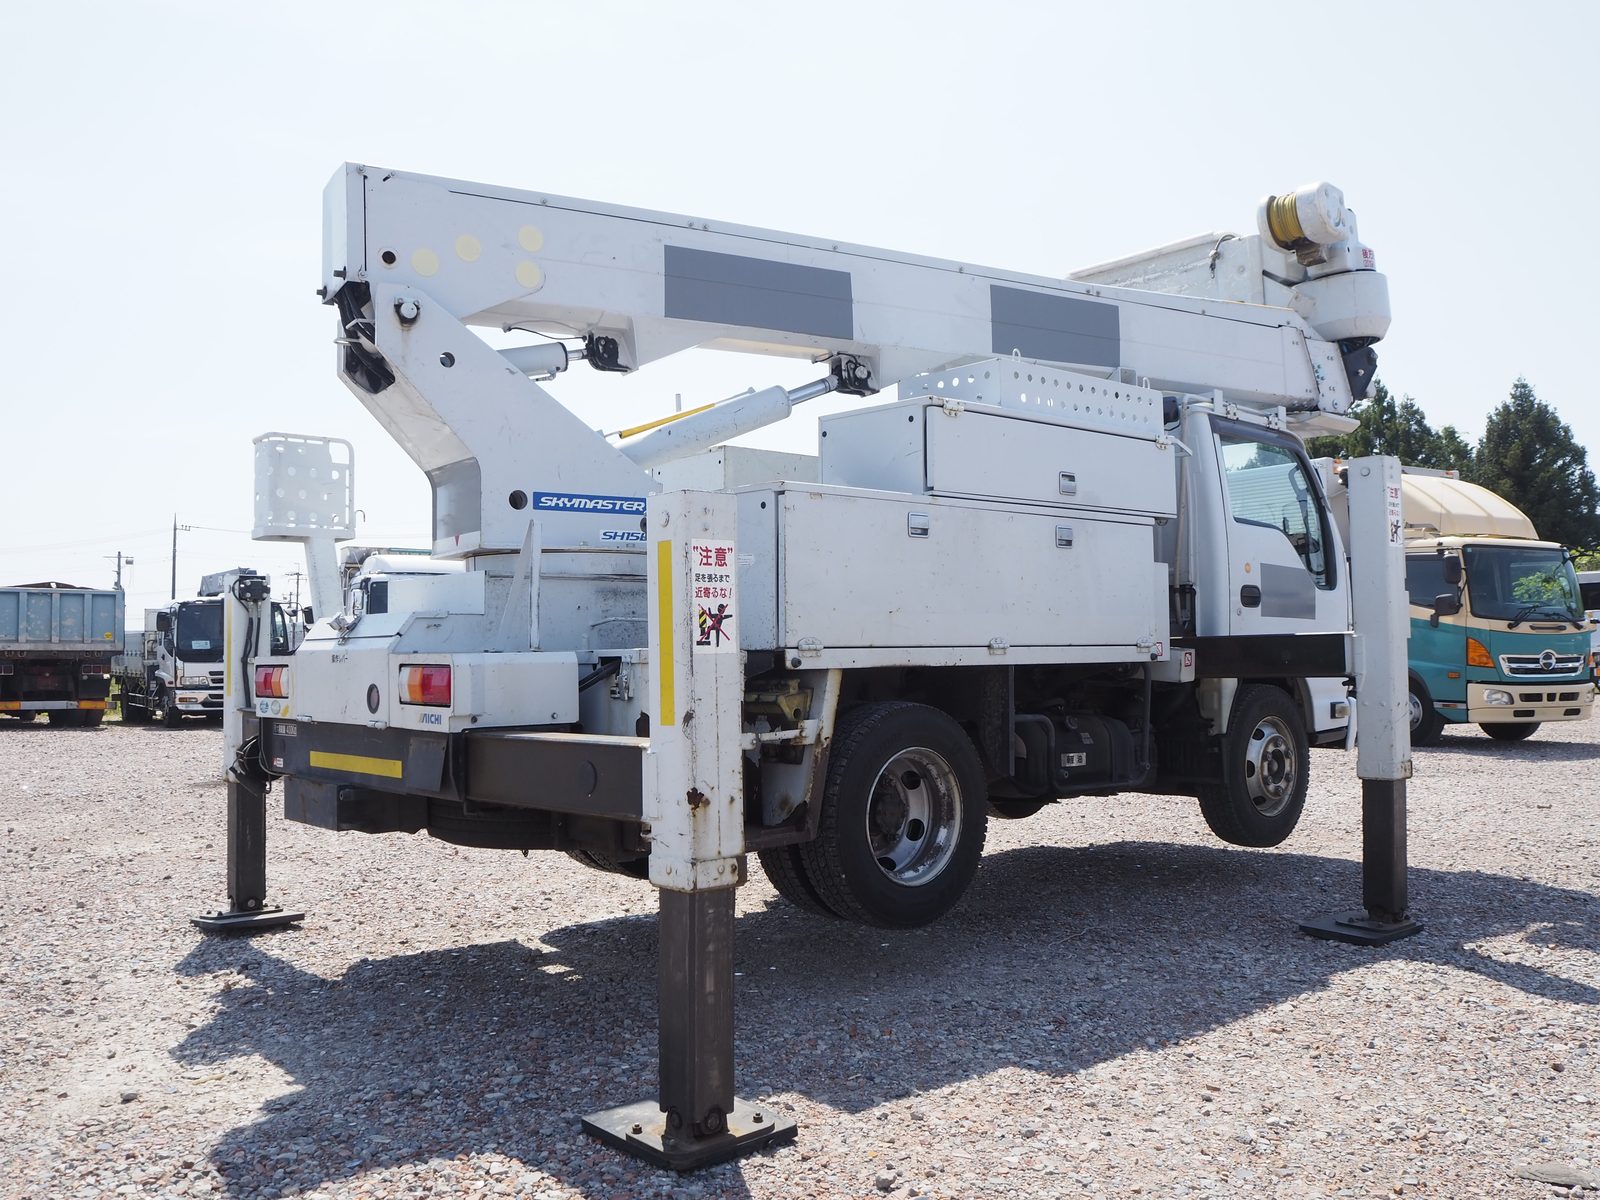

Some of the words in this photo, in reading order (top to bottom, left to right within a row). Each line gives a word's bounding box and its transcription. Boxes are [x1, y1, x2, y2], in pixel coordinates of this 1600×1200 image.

[539, 496, 646, 512] SKYMASTER
[694, 572, 730, 583] 足を張るまで
[694, 586, 732, 599] 近寄るな!
